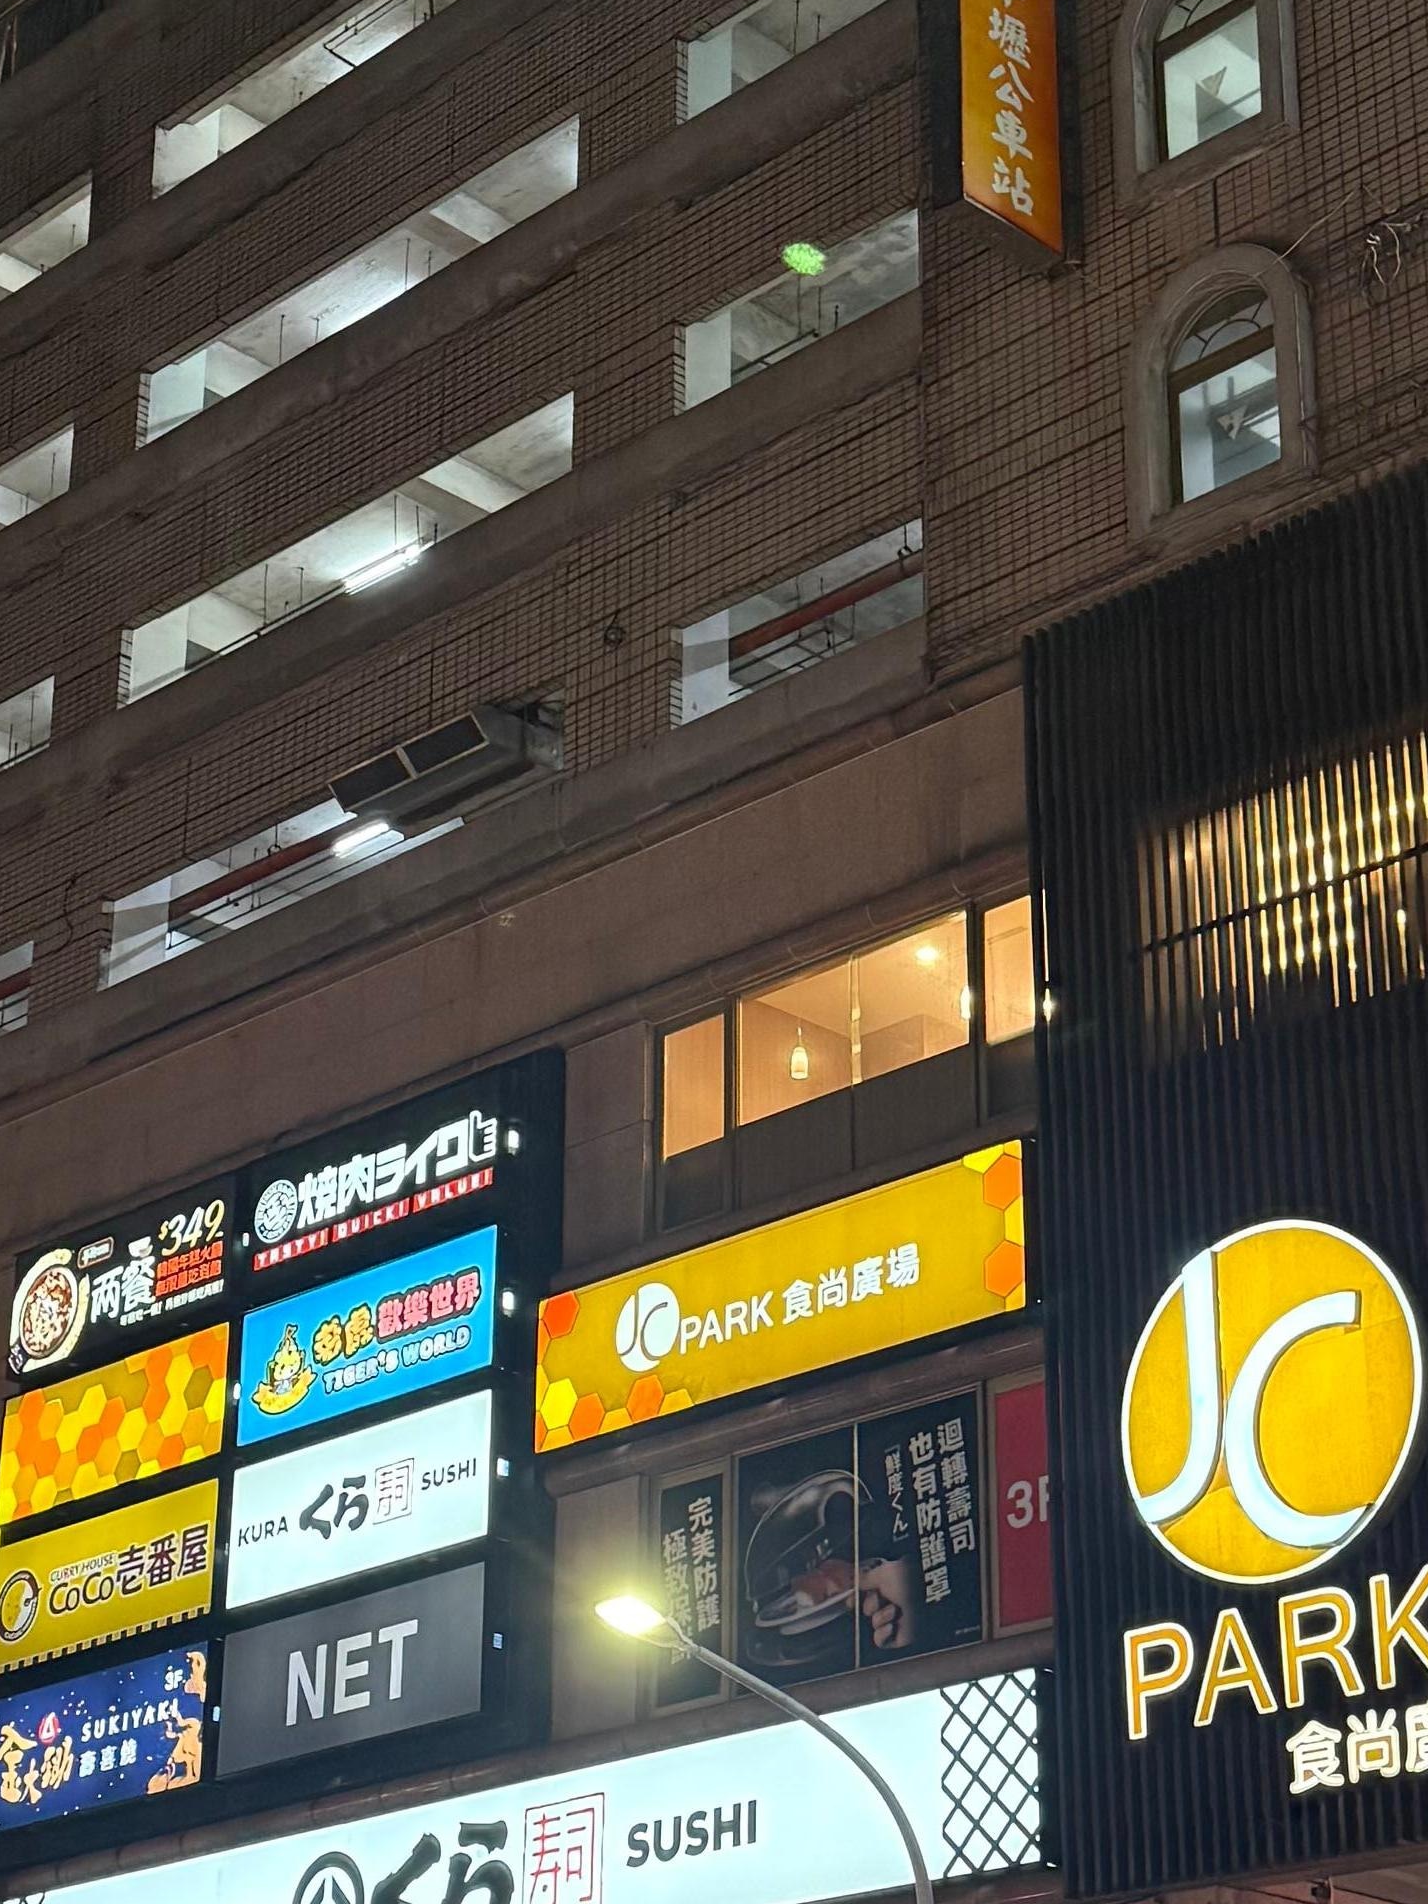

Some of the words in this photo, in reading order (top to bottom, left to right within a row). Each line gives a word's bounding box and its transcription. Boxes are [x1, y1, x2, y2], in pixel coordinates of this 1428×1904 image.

[679, 1290, 775, 1355] PARK
[780, 1242, 921, 1327] 食尚廣場
[237, 1515, 288, 1547] KURA
[420, 1457, 478, 1491] SUSHI
[907, 1430, 952, 1606] 也有防護罩
[936, 1416, 977, 1555] 迴轉壽司
[80, 1554, 115, 1575] HOUSE
[687, 1494, 722, 1634] 完美防護
[80, 1697, 179, 1743] SUKIYAKI
[284, 1618, 419, 1728] NET
[624, 1798, 759, 1871] SUSHI
